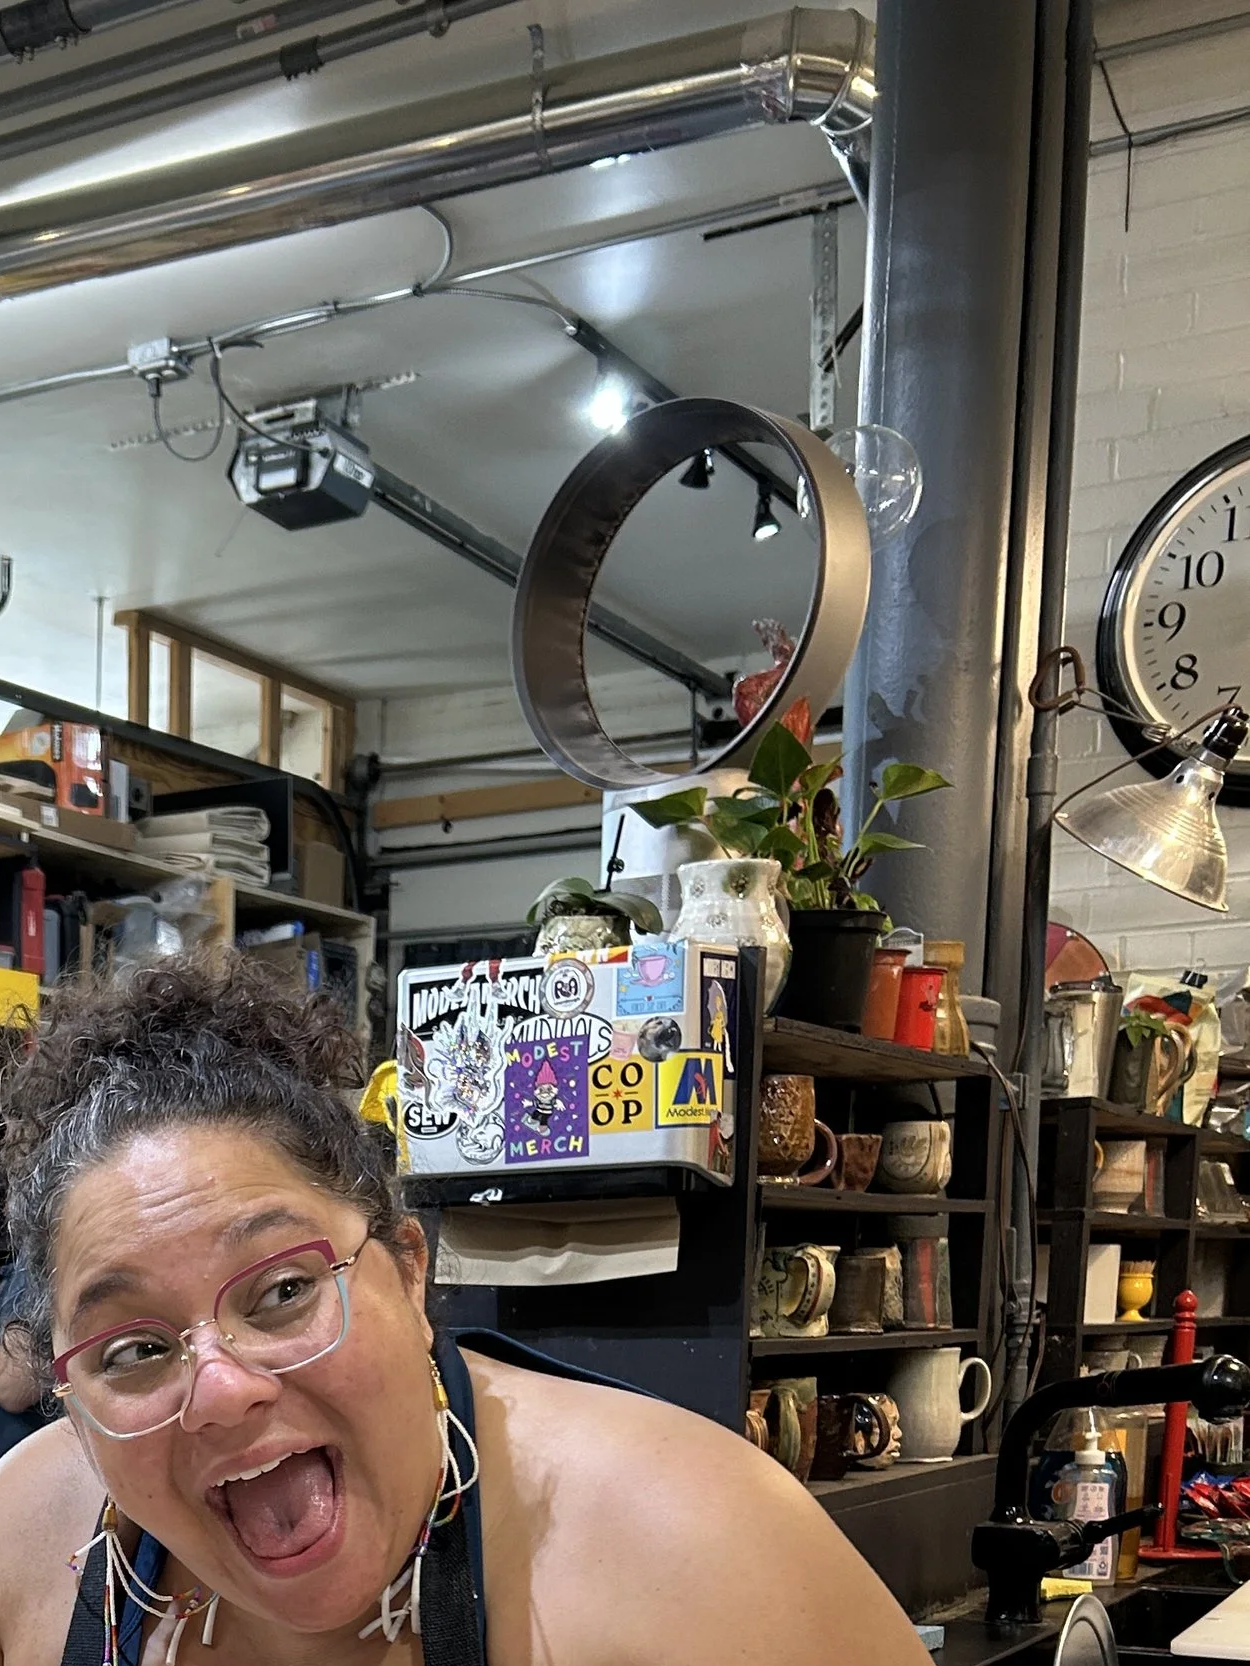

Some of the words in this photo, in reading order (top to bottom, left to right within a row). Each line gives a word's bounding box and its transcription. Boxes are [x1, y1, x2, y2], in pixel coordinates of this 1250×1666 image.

[1222, 505, 1250, 543] 1
[1177, 550, 1224, 591] 10
[1157, 601, 1187, 643] 9
[1170, 653, 1199, 691] 8
[412, 982, 480, 1031] MOD
[505, 1040, 584, 1068] MODEST
[592, 1061, 643, 1090] CO
[408, 1106, 451, 1127] SEW
[592, 1100, 643, 1125] OP
[510, 1135, 584, 1157] MERCH
